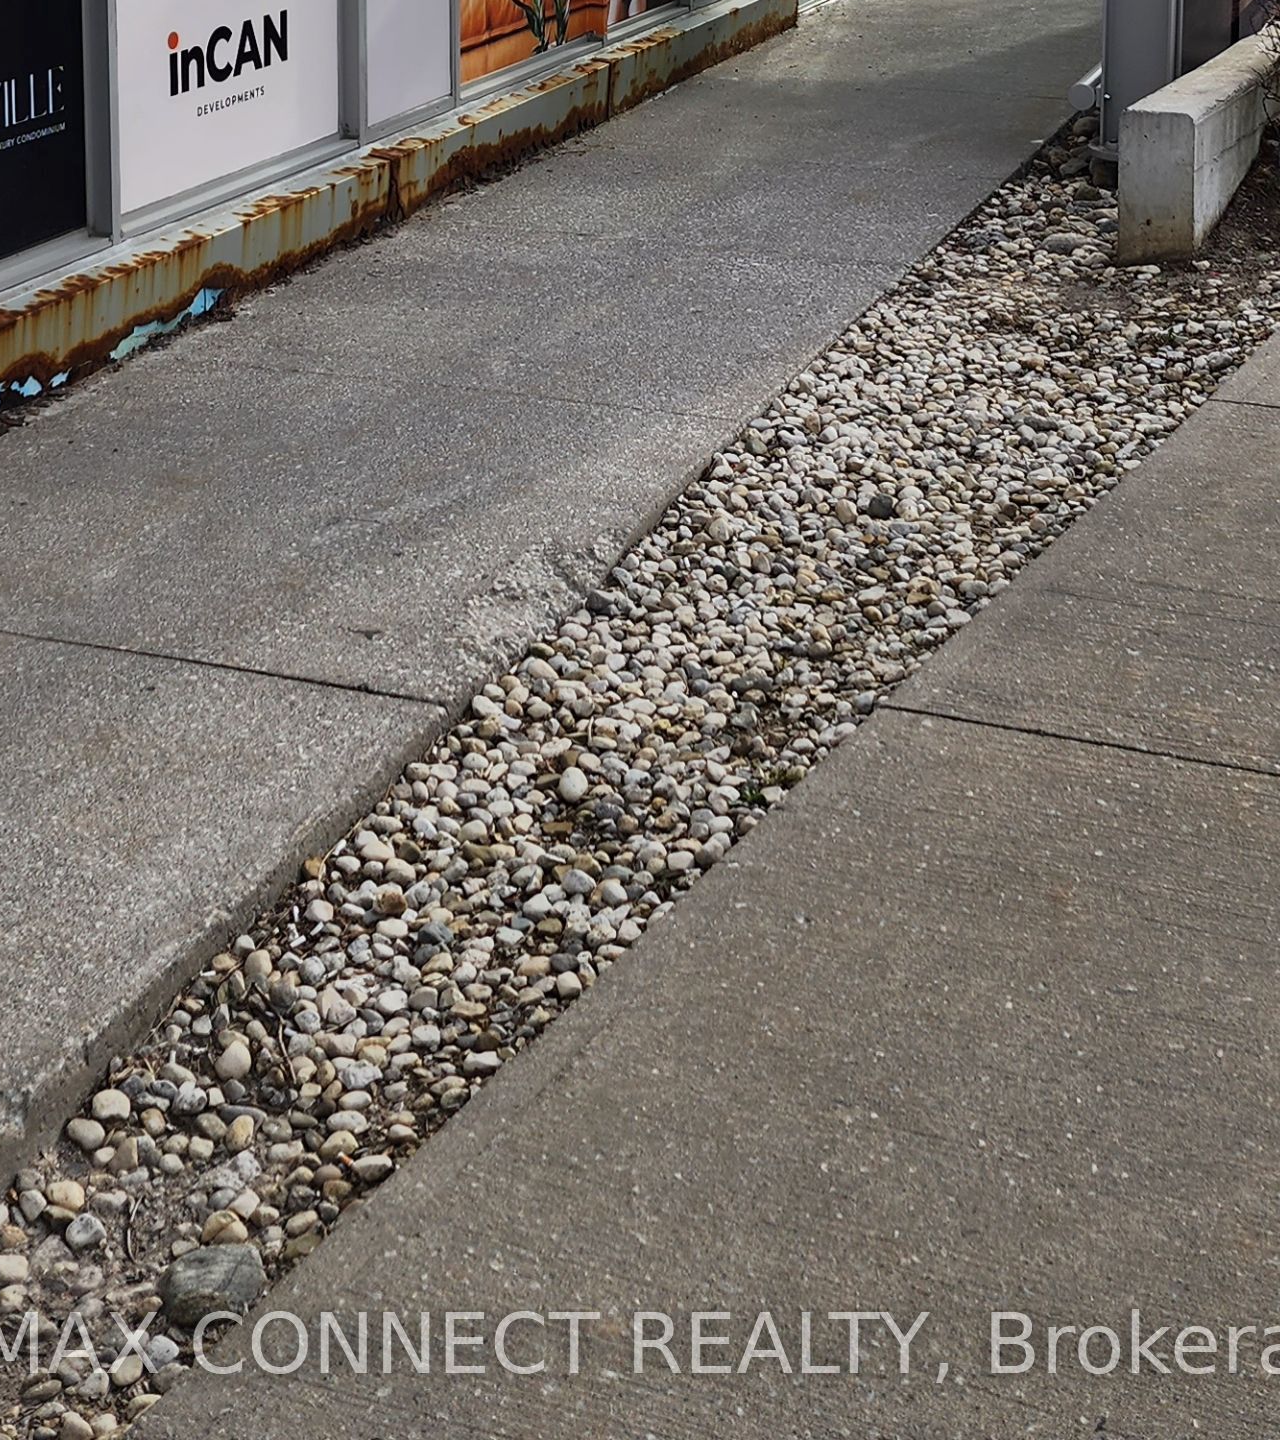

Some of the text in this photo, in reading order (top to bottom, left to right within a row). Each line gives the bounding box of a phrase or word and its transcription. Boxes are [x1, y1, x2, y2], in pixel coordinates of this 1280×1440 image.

[167, 9, 288, 97] inCAN
[197, 85, 265, 117] DEVELOPMENTS
[16, 122, 66, 145] CONDOMINIUM
